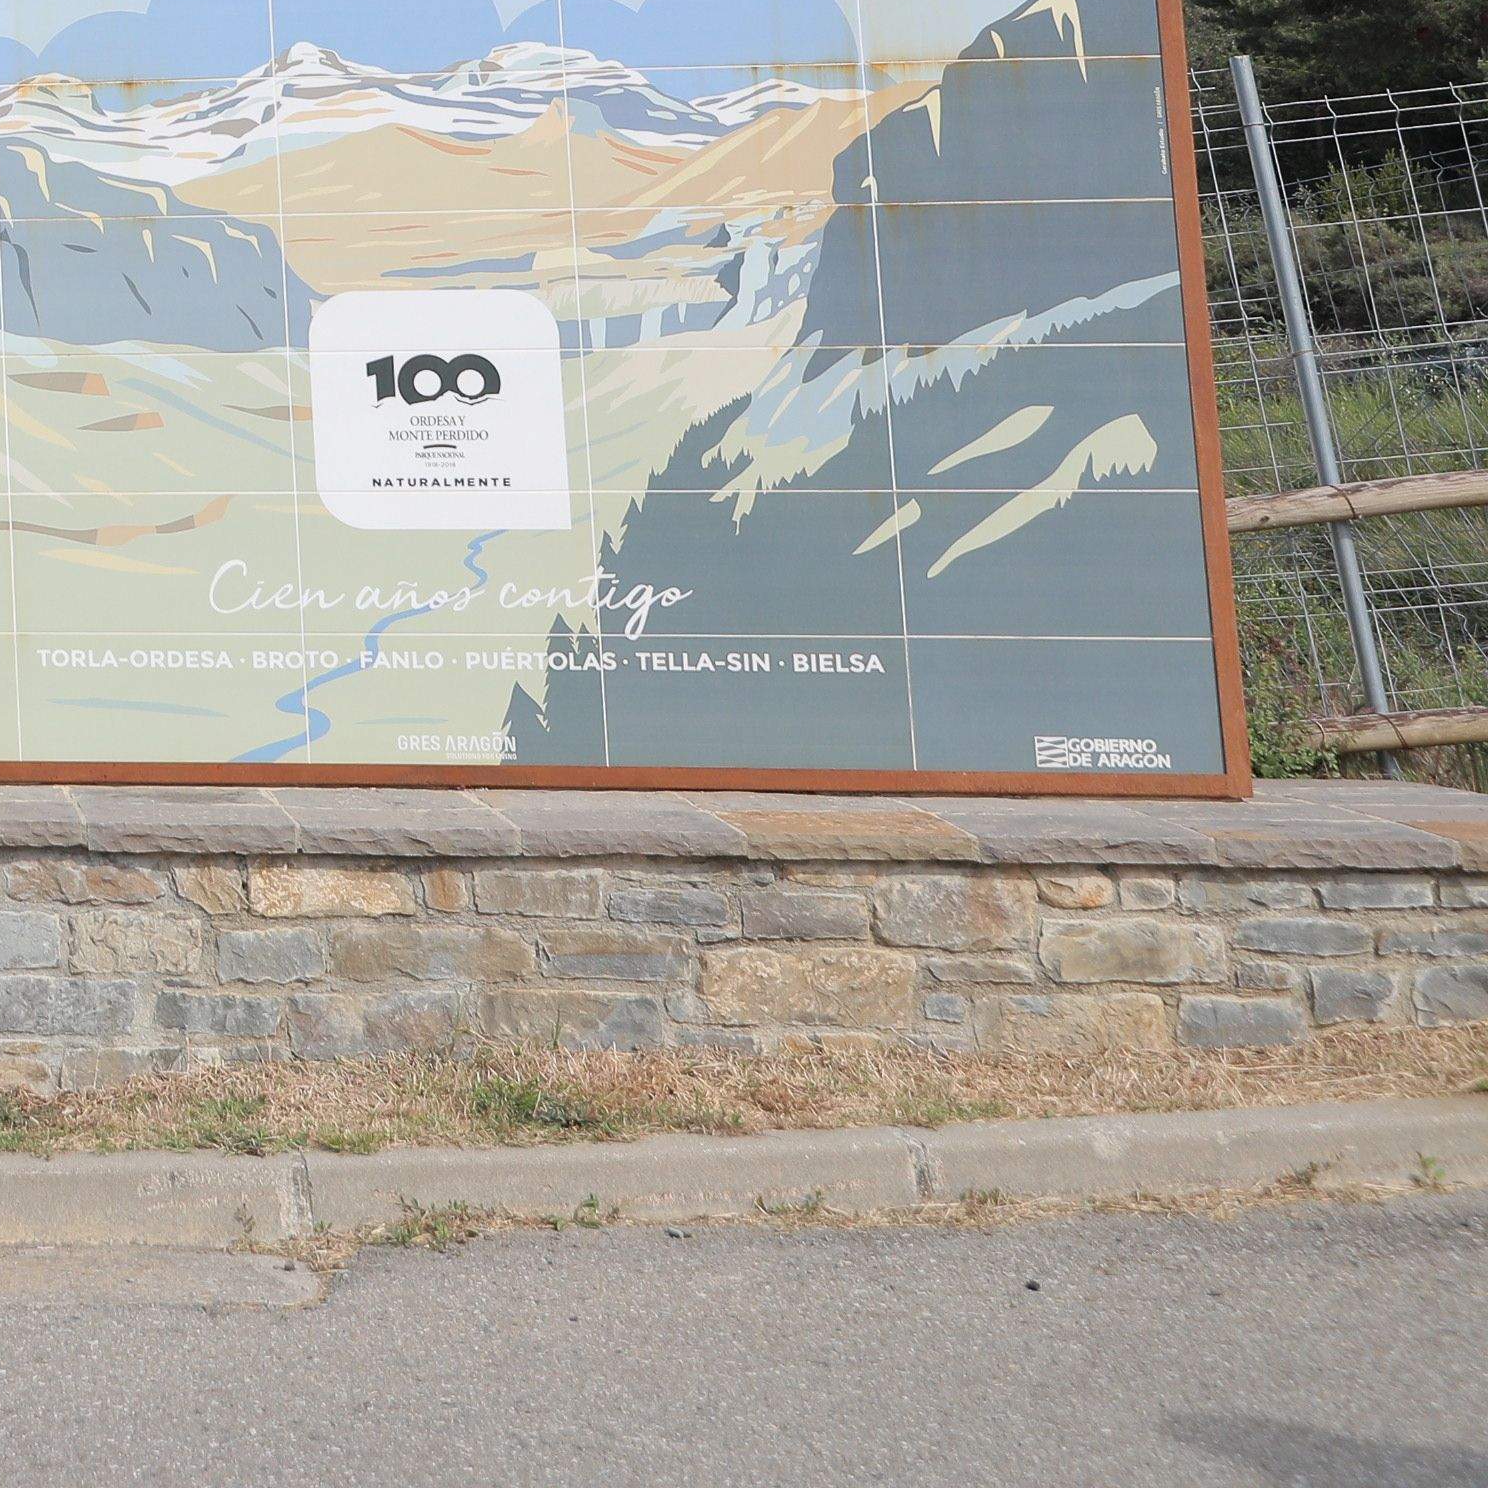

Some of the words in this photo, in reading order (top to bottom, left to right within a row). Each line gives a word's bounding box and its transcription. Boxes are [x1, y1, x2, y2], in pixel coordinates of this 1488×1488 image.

[365, 353, 501, 405] 100
[409, 415, 457, 427] ORDESA
[457, 415, 466, 426] Y
[388, 430, 432, 442] MONTE
[435, 429, 489, 441] PERDIDO
[372, 477, 511, 487] NATURALMENTE
[209, 559, 346, 614] Cien
[355, 580, 488, 611] años
[499, 565, 694, 641] contigo
[37, 649, 234, 669] TORLA-ORDESA
[252, 649, 339, 670] BROTO
[360, 650, 444, 670] FANLO
[466, 647, 617, 671] PUÉRTOLAS
[636, 652, 770, 672] TELLA-SIN
[793, 652, 886, 674] BIELSA
[397, 735, 441, 751] GRES
[1068, 738, 1157, 753] GOBIERNO
[1069, 754, 1092, 767] DE
